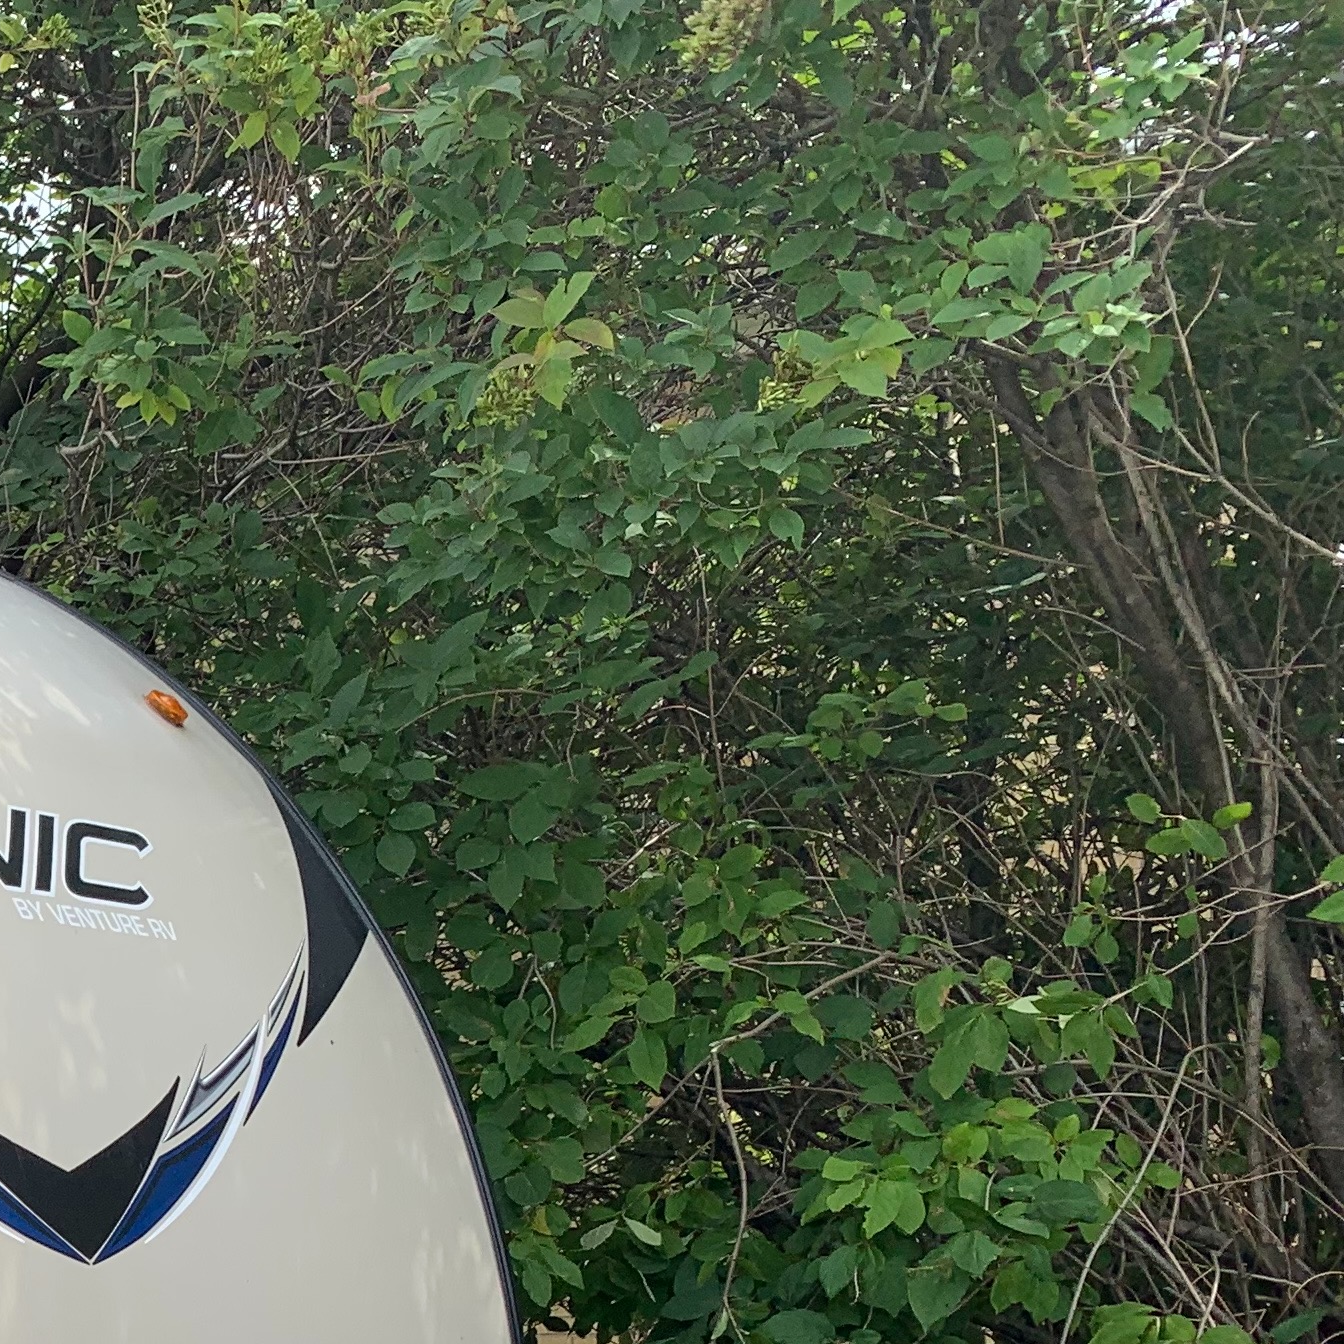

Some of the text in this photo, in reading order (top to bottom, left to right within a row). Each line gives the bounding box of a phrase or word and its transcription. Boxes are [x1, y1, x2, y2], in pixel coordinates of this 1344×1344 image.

[16, 899, 177, 941] BY VENTURE RV
